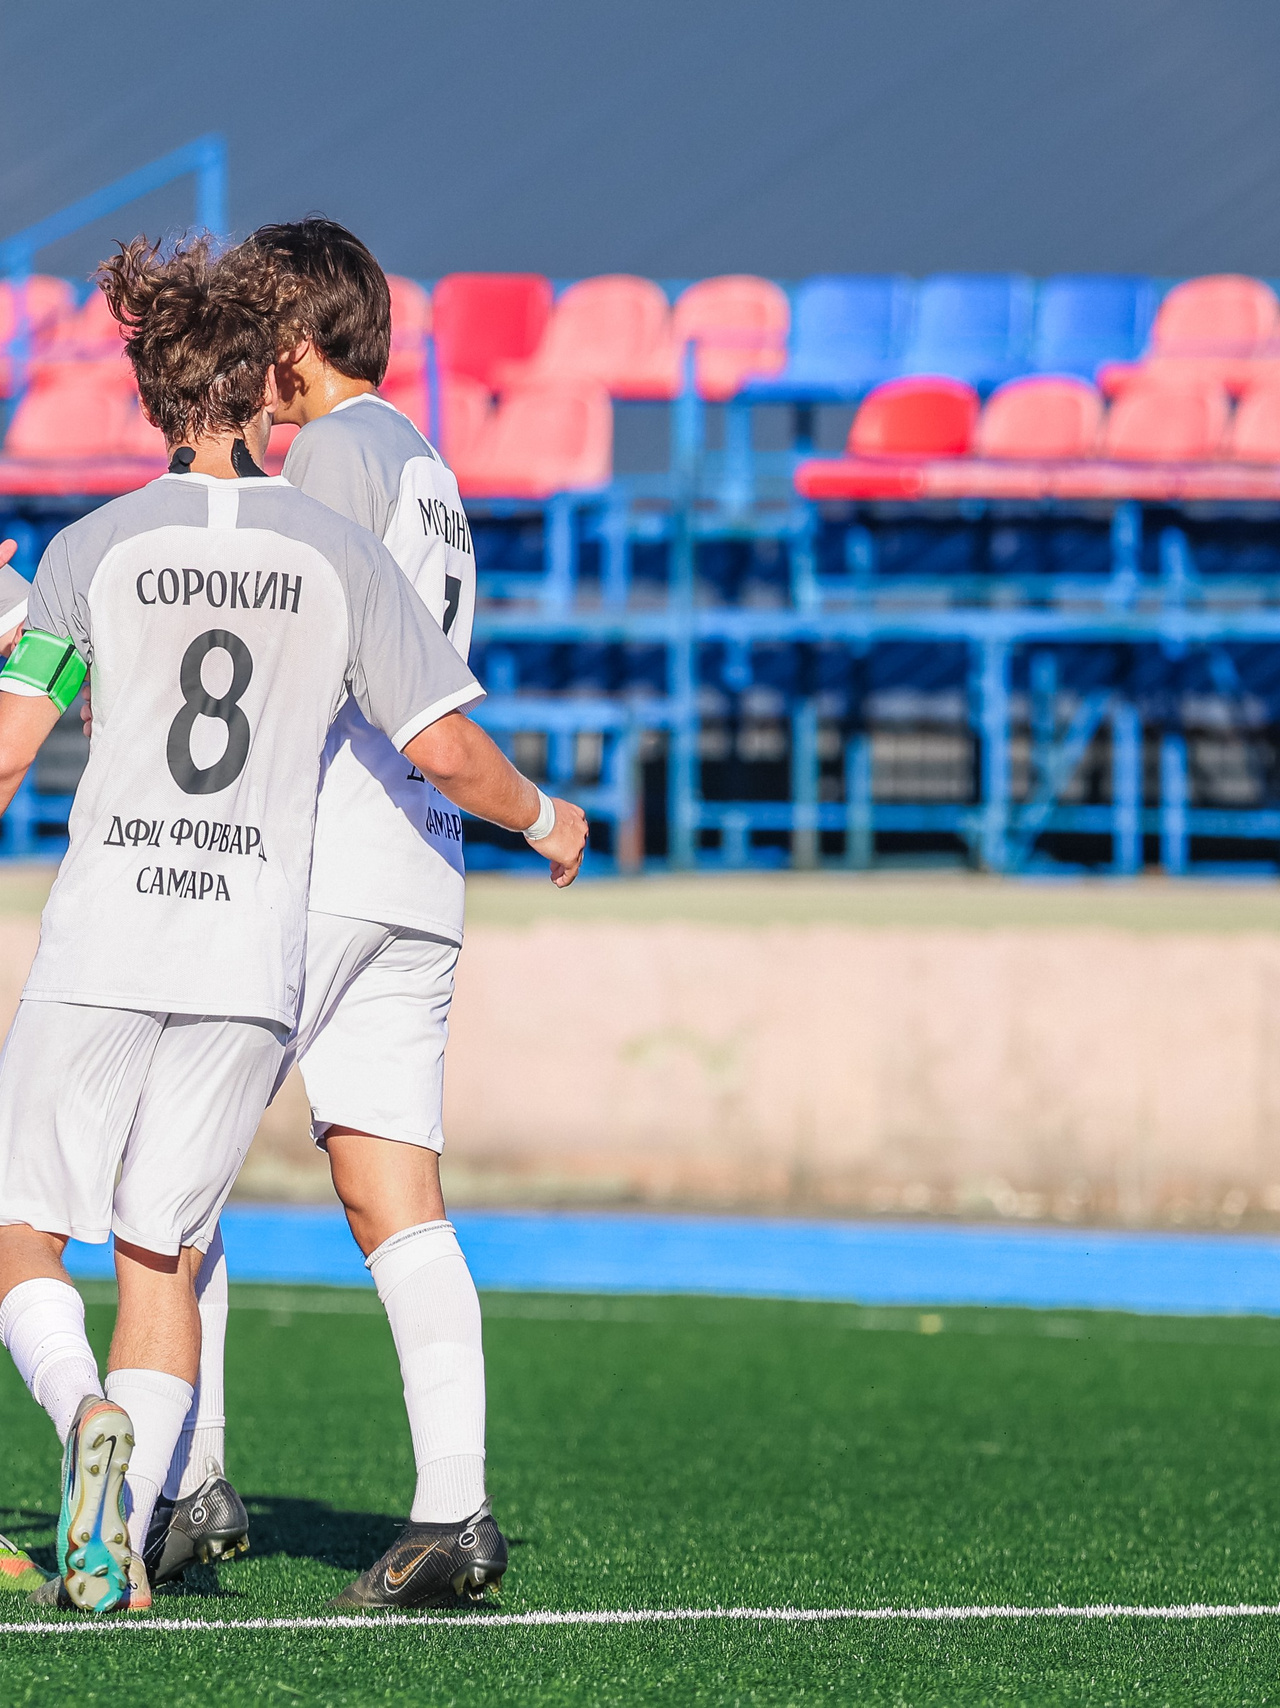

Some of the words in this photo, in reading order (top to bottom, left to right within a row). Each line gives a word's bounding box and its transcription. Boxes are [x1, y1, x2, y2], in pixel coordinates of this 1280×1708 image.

[136, 568, 303, 614] СОРОКИН
[167, 629, 253, 795] 8
[103, 815, 165, 848] ДФЦ
[136, 866, 231, 901] САМАРА
